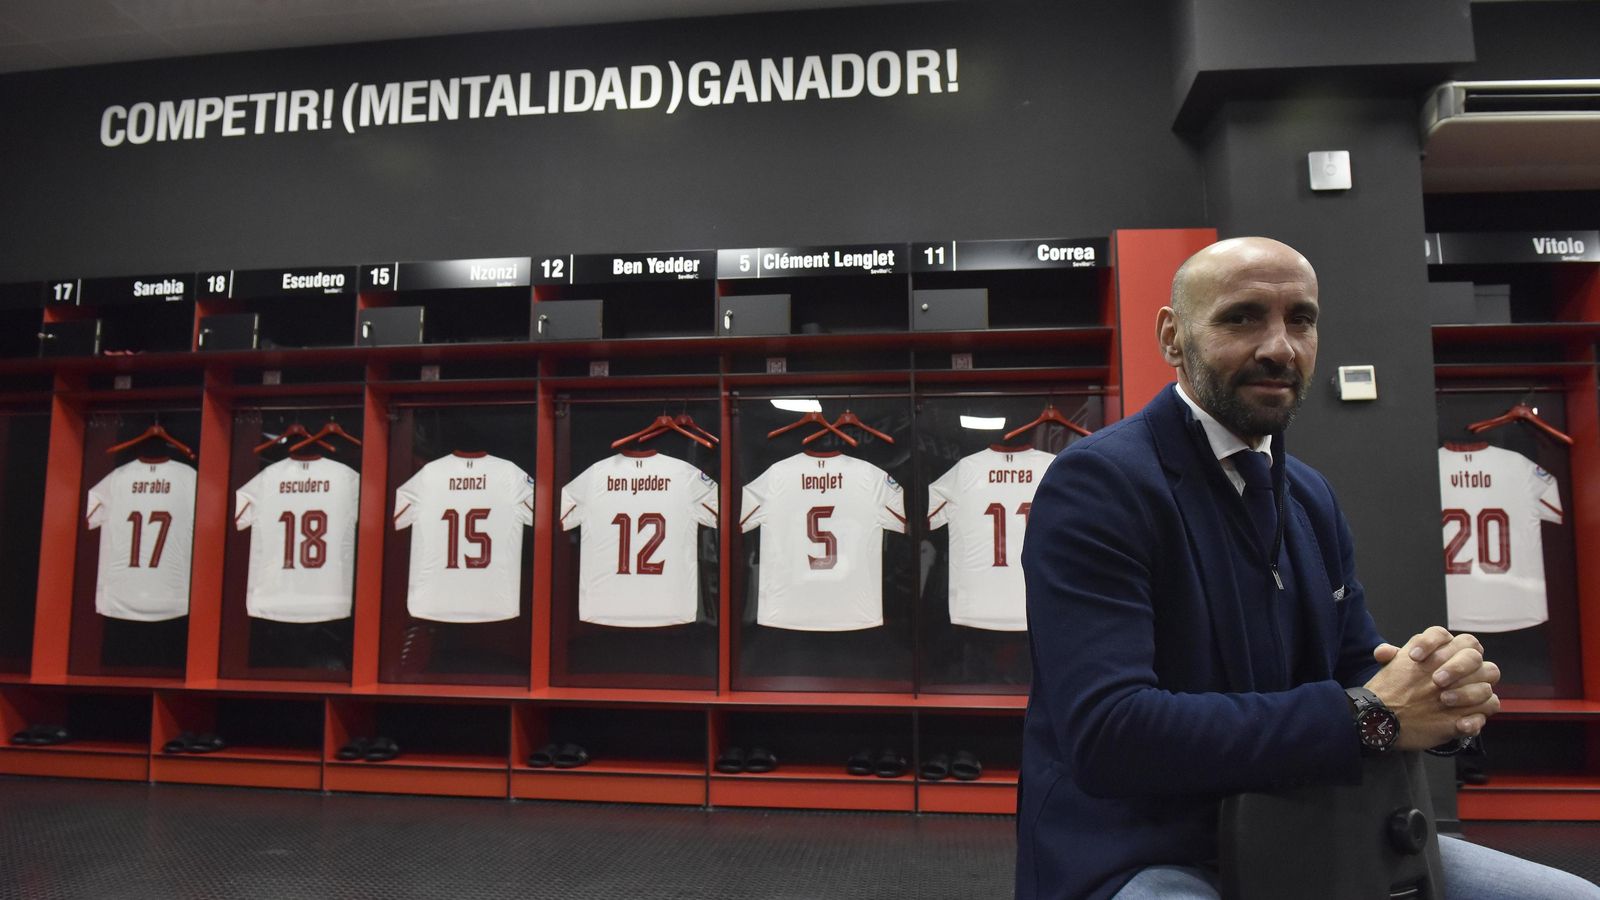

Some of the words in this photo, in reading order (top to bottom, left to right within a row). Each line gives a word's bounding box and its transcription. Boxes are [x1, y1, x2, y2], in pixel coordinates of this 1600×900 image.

[100, 88, 334, 146] COMPETIR!
[923, 246, 945, 265] 11
[1037, 244, 1095, 262] Correa
[1533, 237, 1584, 255] Vitolo
[613, 258, 643, 275] Ben
[647, 256, 701, 274] Yedder
[739, 254, 750, 272] 5
[762, 247, 830, 270] Clément
[834, 249, 895, 270] Lenglet
[370, 267, 390, 286] 15
[470, 263, 518, 281] Nzonzi
[540, 258, 564, 279] 12
[133, 279, 185, 297] Sarabia
[207, 275, 226, 293] 18
[282, 272, 345, 290] Escudero
[53, 283, 73, 300] 17
[279, 477, 330, 494] escudero
[448, 474, 487, 491] nzonzi
[607, 475, 629, 492] ben
[631, 475, 672, 496] yedder
[801, 472, 844, 494] lenglet
[988, 468, 1033, 484] correa
[1450, 470, 1492, 489] vitolo
[131, 478, 171, 494] sarabia
[126, 510, 172, 568] 17
[278, 509, 328, 569] 18
[441, 508, 492, 569] 15
[611, 512, 666, 575] 12
[806, 505, 837, 570] 5
[1442, 507, 1512, 575] 20
